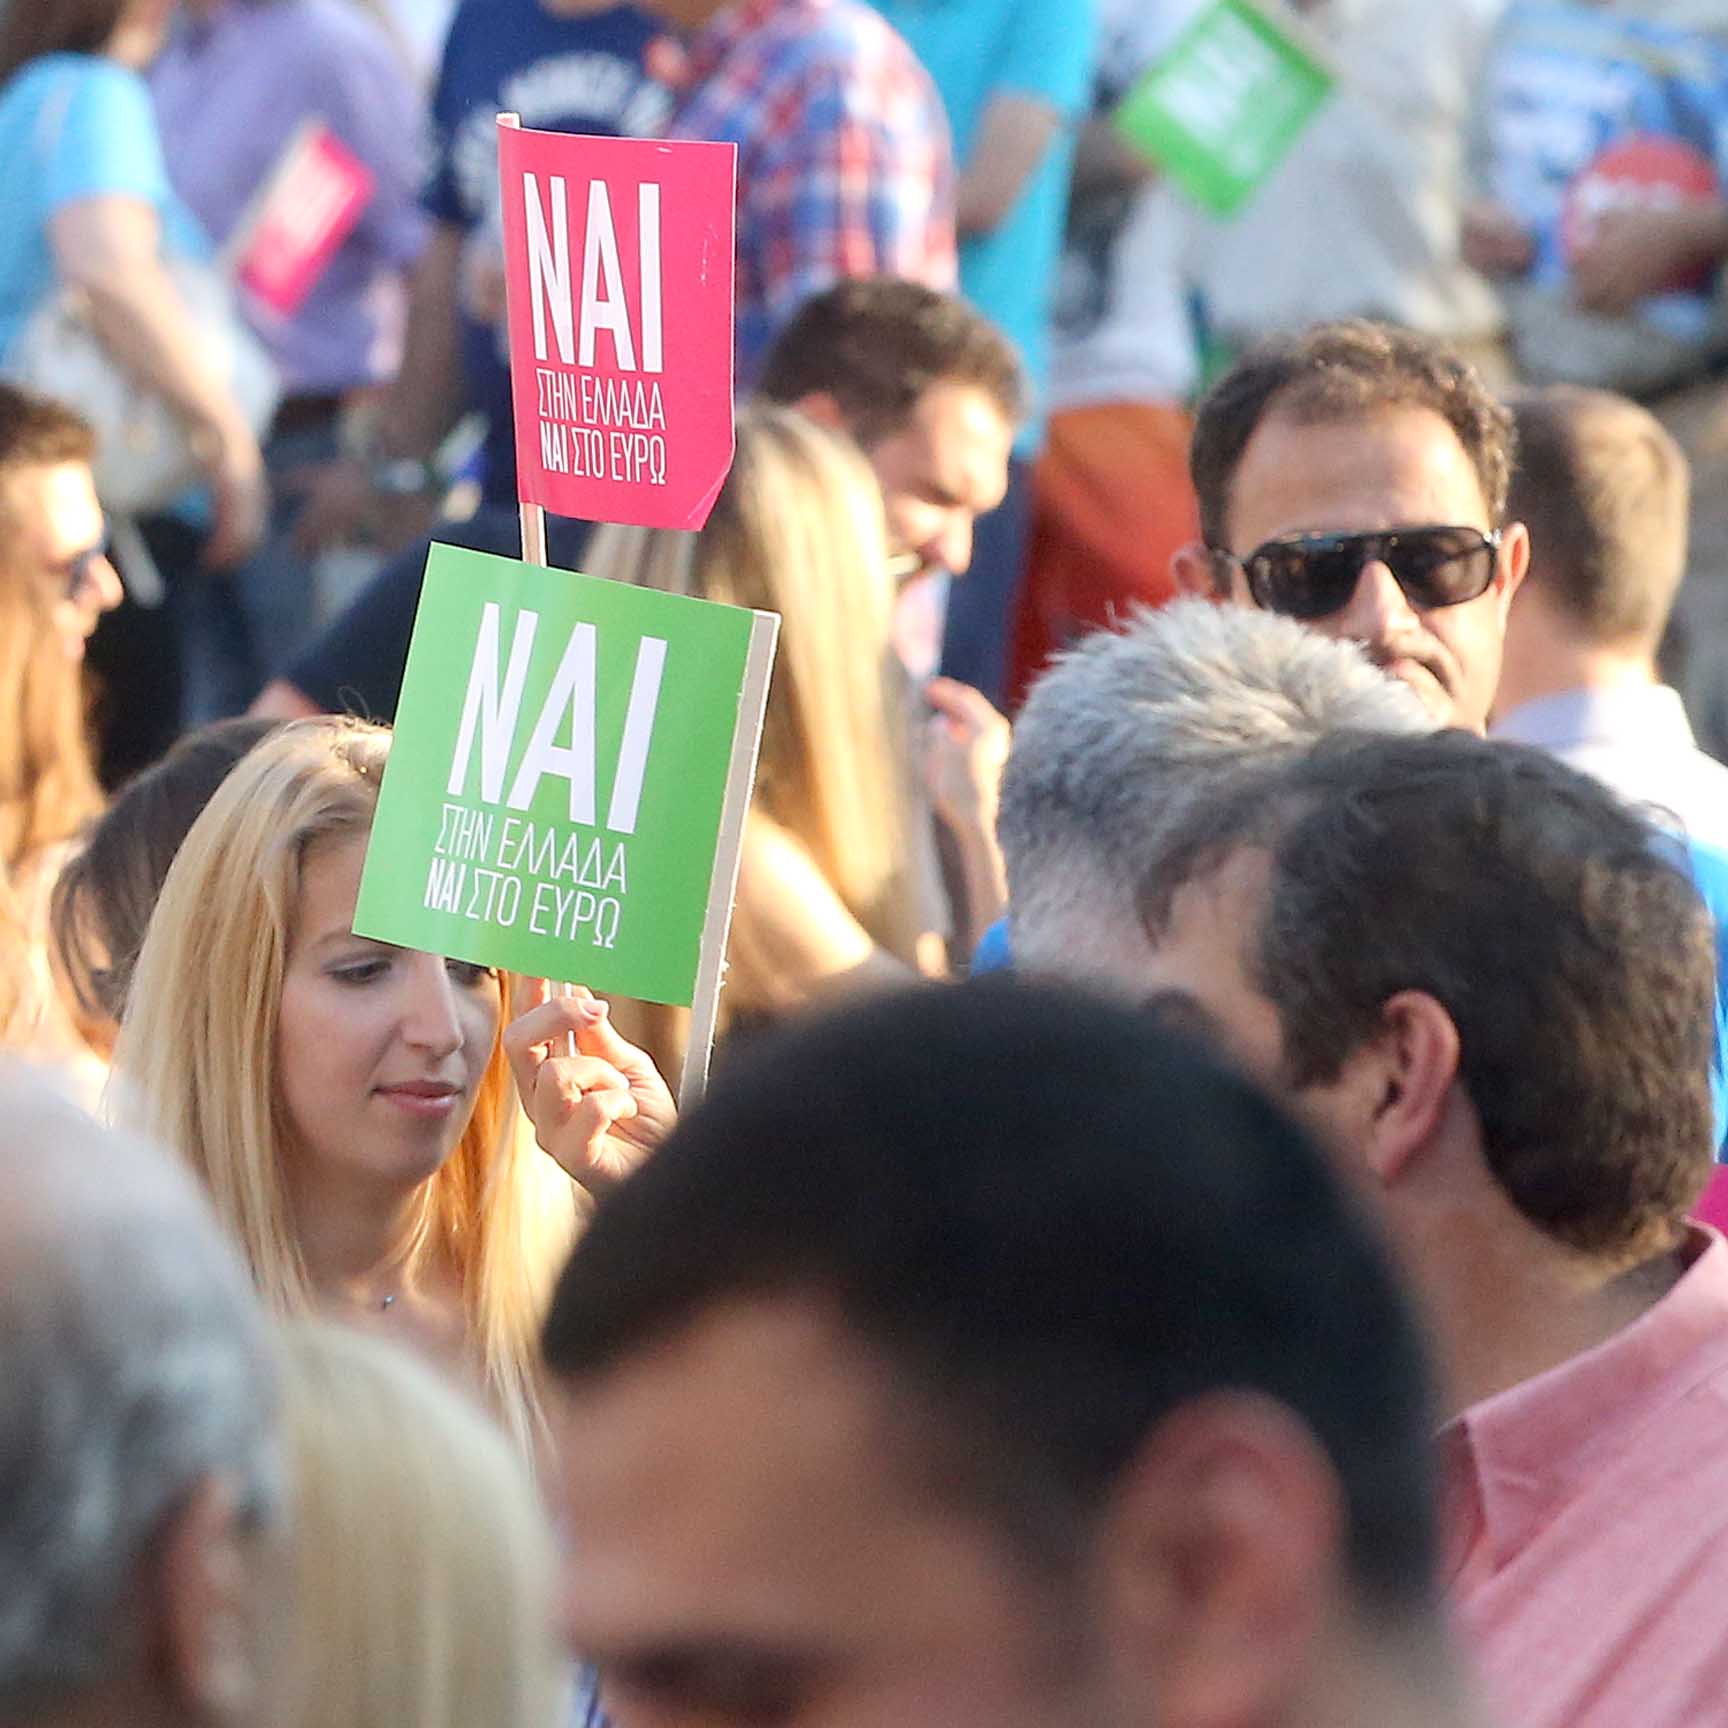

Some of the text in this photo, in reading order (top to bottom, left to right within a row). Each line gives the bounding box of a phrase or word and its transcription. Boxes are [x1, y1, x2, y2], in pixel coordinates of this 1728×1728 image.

[523, 173, 663, 372] ΝΑΙ
[536, 368, 666, 431] ΣΤΗΝ ΕΛΛΑΔΑ
[540, 421, 667, 485] ΝΑΙ ΣΤΟ ΕΥΡΩ
[447, 602, 667, 834] ΝΑΙ
[434, 802, 628, 894] ΣΤΗΝ ΕΛΛΑΔΑ
[424, 857, 623, 949] ΝΑΙ ΣΤΟ ΕΥΡΩ
